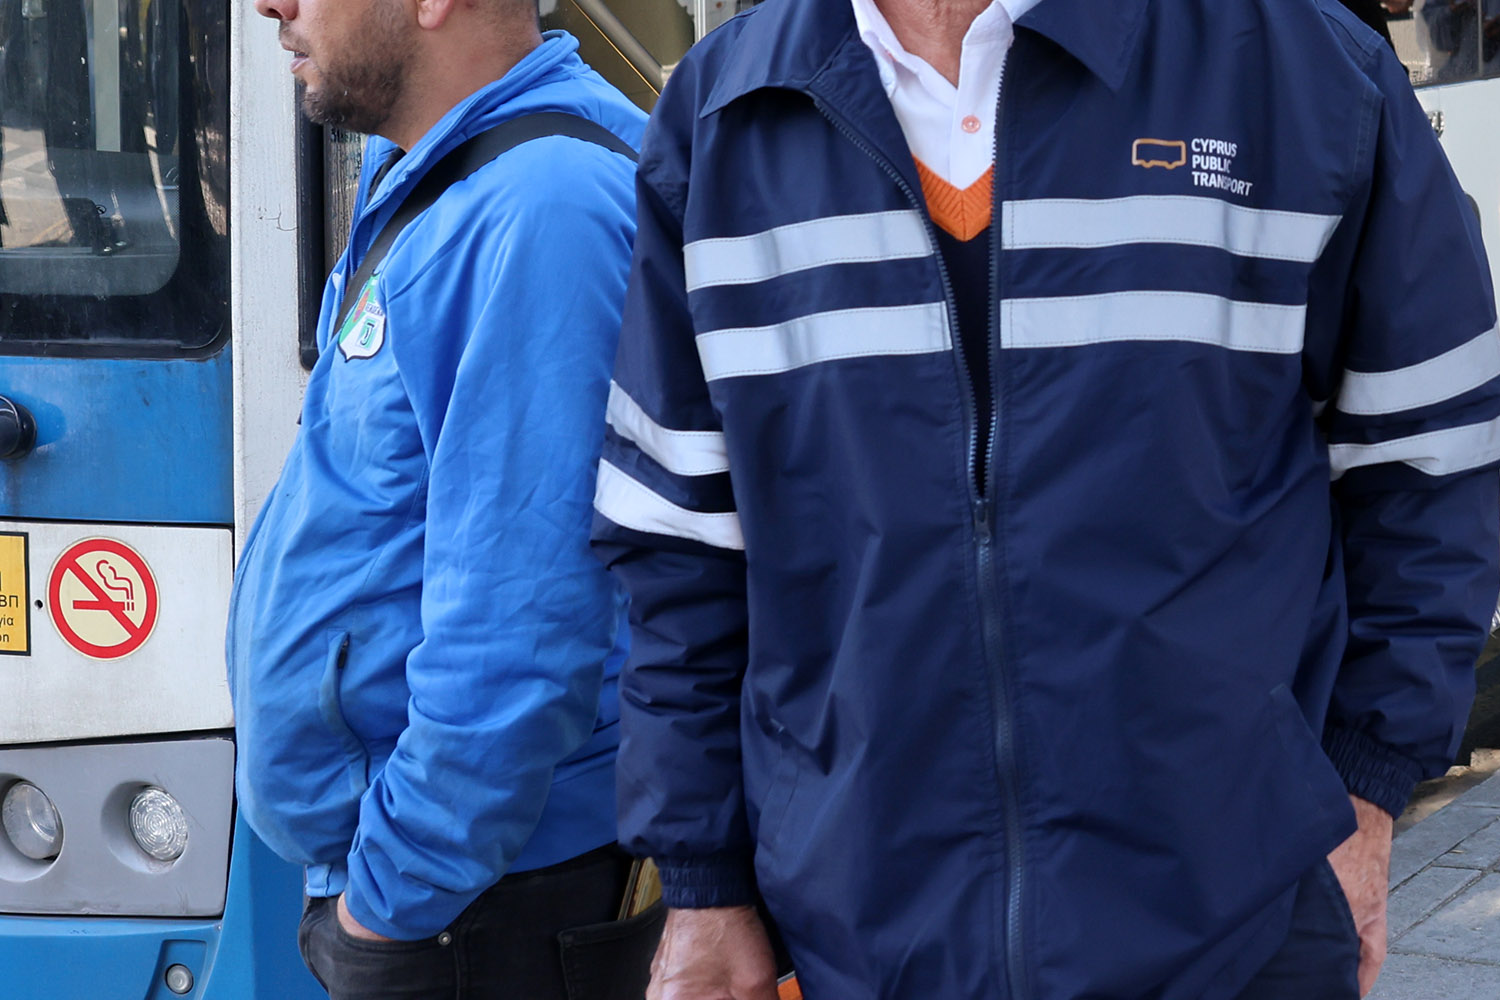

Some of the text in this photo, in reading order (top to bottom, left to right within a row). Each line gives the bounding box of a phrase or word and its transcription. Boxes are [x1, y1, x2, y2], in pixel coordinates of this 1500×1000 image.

[1191, 138, 1238, 158] CYPRUS
[1192, 155, 1232, 174] PUBLIC
[1191, 171, 1253, 196] TRANSPORT
